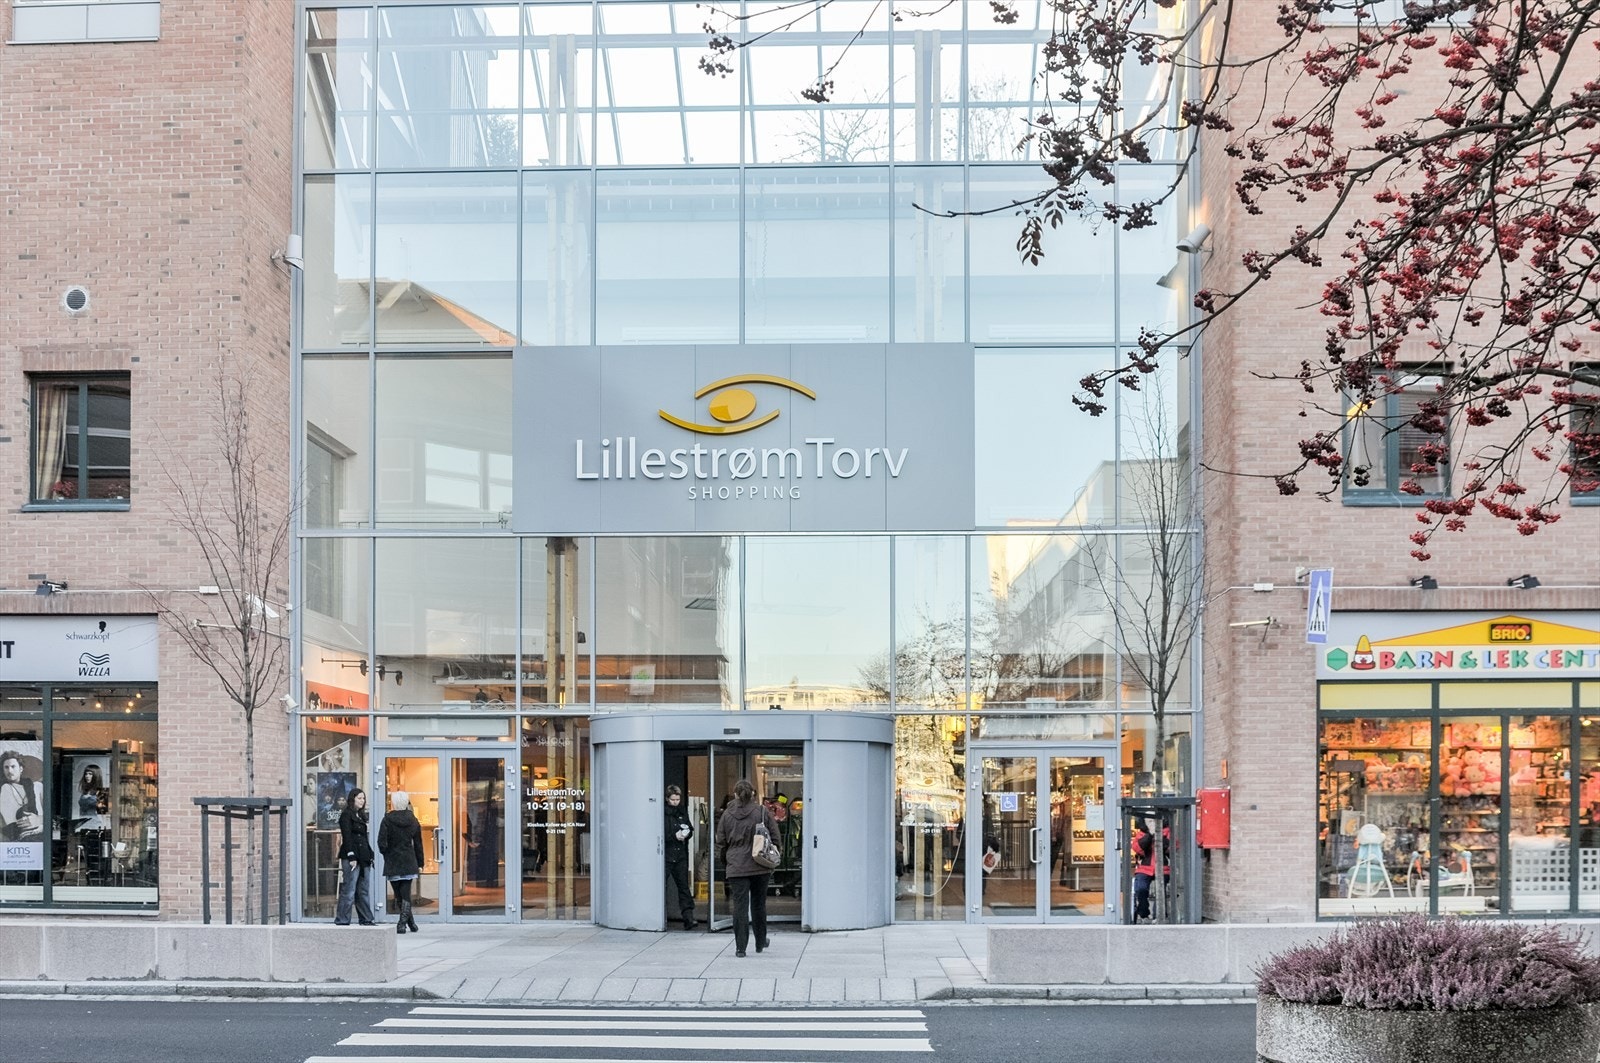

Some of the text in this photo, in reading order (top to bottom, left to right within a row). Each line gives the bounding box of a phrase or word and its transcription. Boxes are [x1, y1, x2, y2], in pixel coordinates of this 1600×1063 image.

[688, 486, 801, 500] SHOPPING
[66, 632, 110, 642] Schwarzkopf
[1379, 650, 1600, 669] BARN & LEK CENT
[78, 667, 110, 676] WELLA
[526, 802, 585, 811] 10-21 (9-18)
